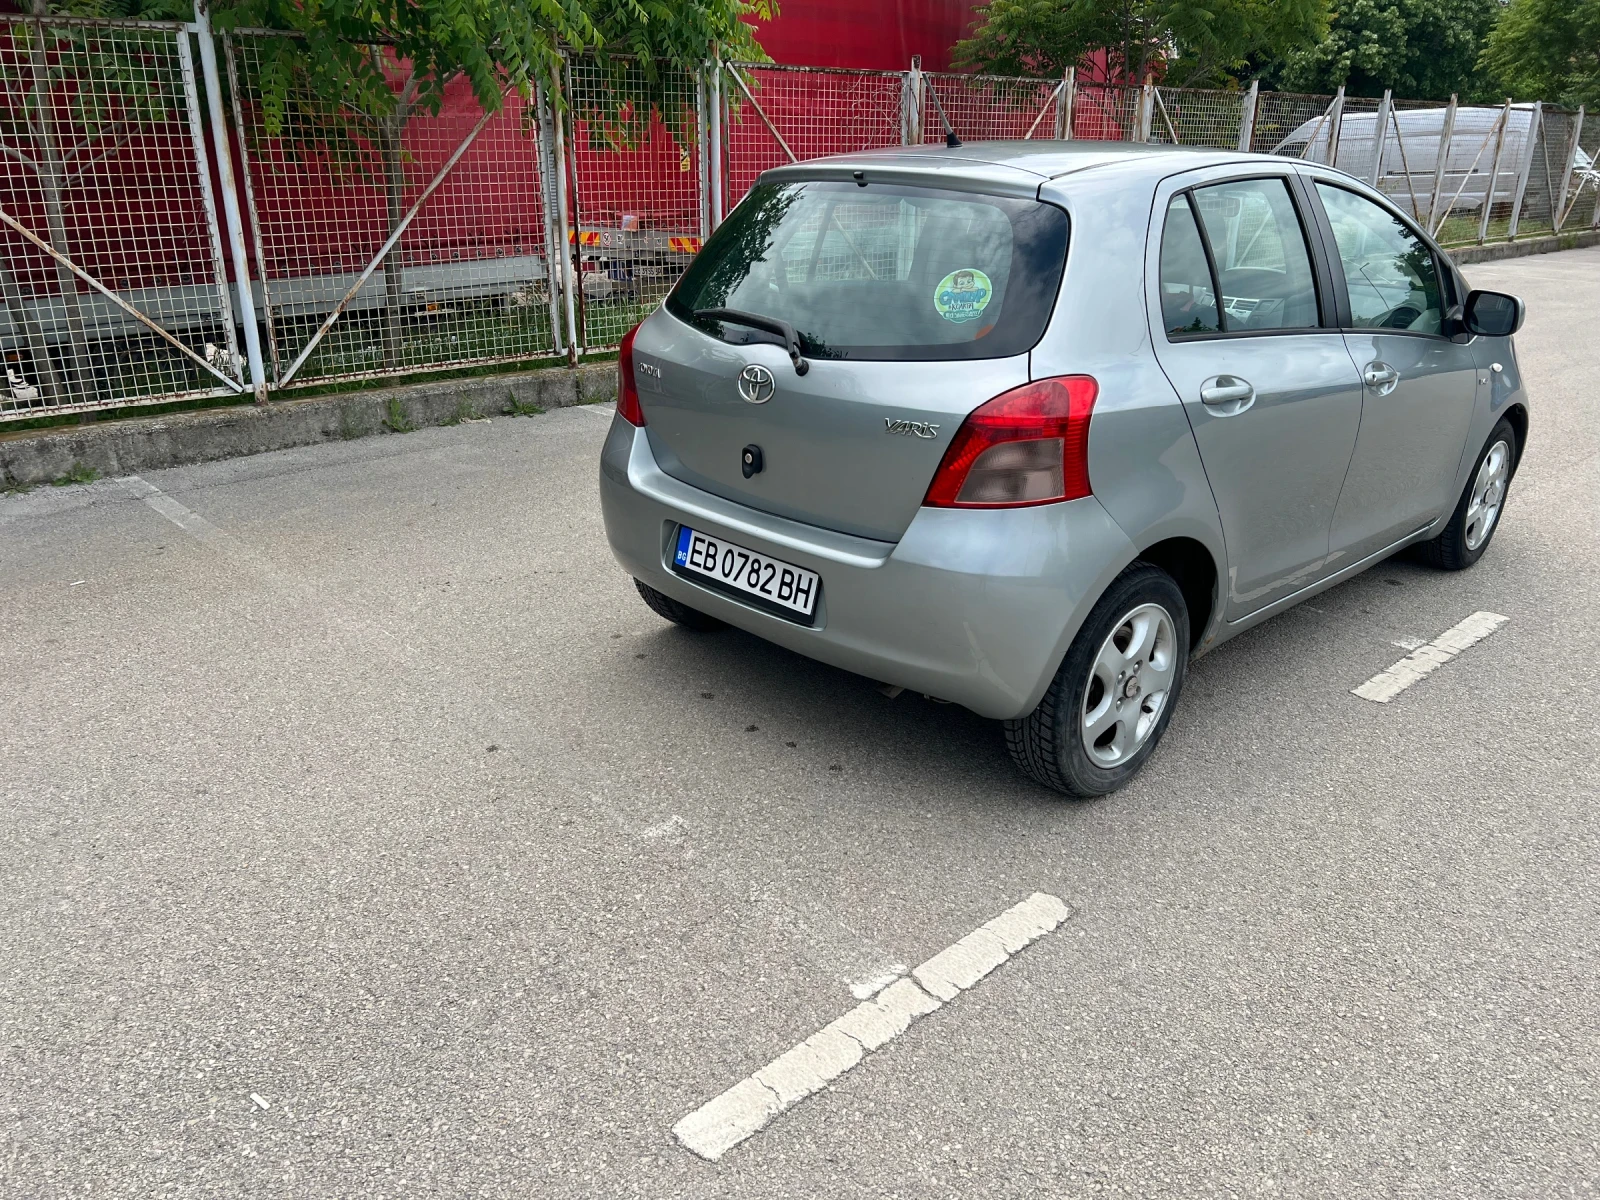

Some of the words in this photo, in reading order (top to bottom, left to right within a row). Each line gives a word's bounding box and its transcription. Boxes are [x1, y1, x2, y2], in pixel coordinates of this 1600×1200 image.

[677, 551, 687, 561] BG
[689, 536, 718, 572] EB
[721, 549, 777, 595] 0782
[777, 568, 813, 609] BH
